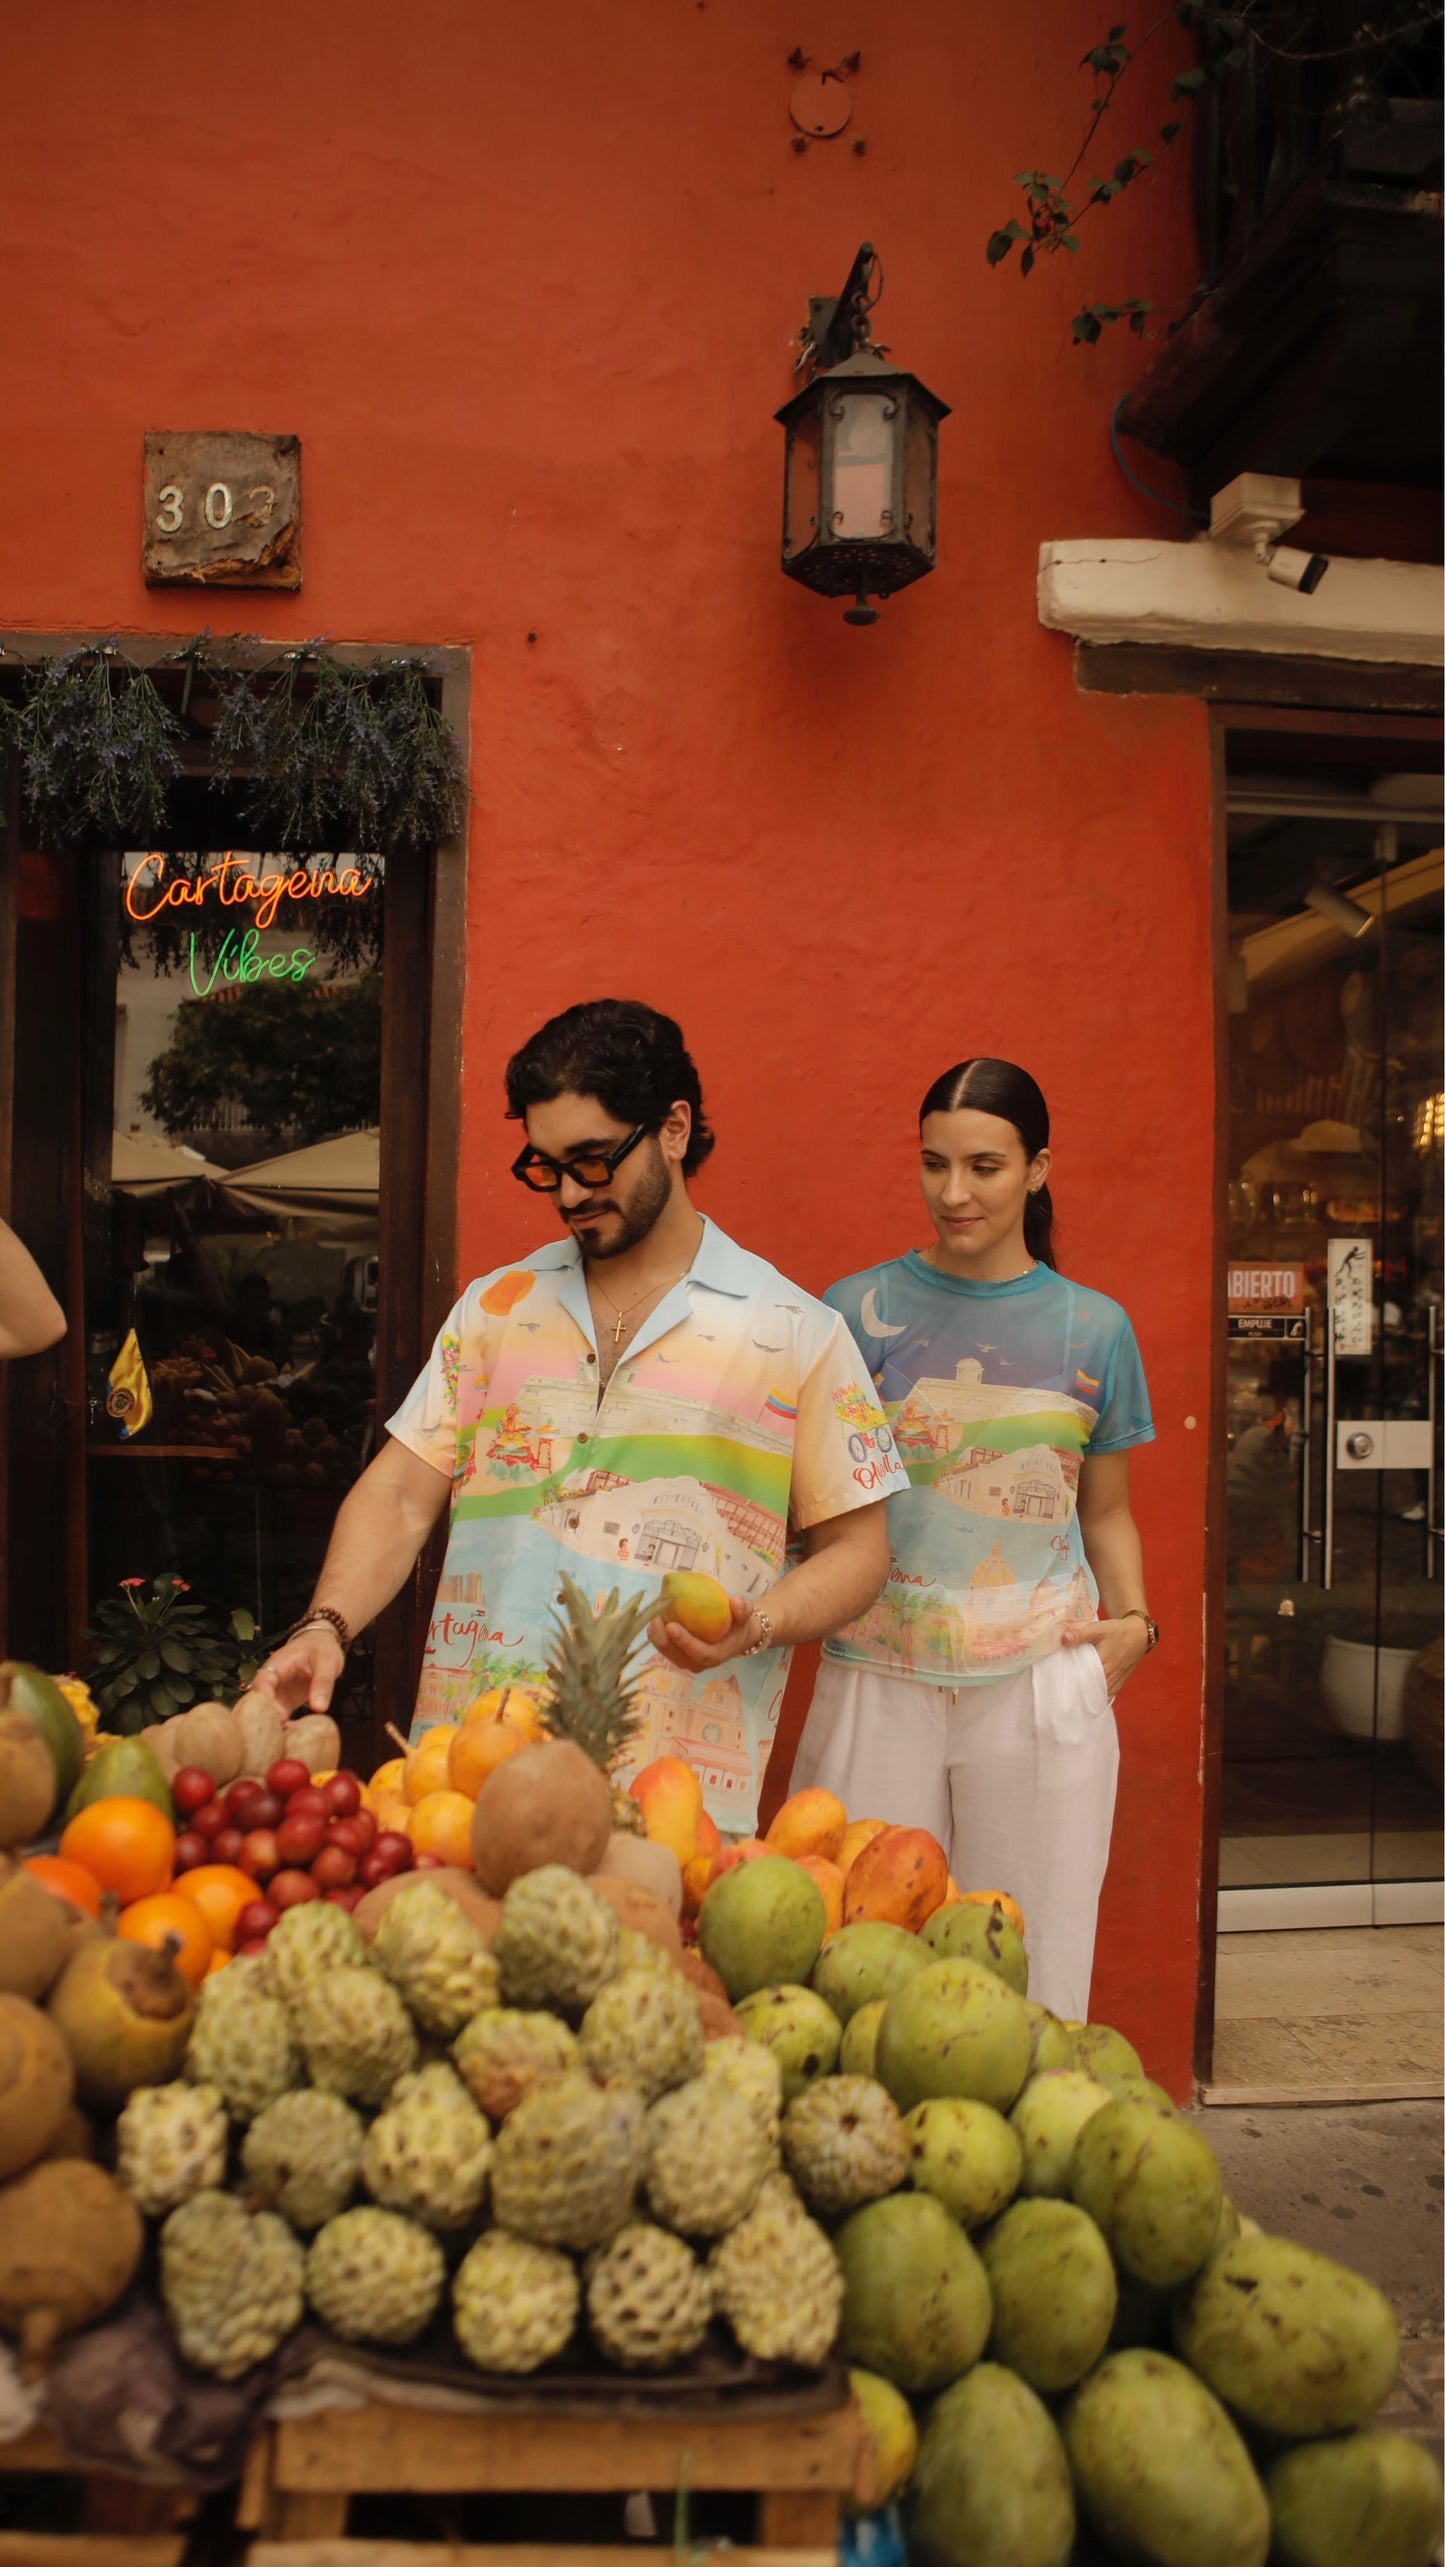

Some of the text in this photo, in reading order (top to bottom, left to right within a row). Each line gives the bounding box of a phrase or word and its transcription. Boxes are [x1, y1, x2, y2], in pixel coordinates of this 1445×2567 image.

[125, 851, 374, 929] Cartagena
[189, 928, 316, 998] Vibes
[1237, 1318, 1272, 1329] EMPUJE
